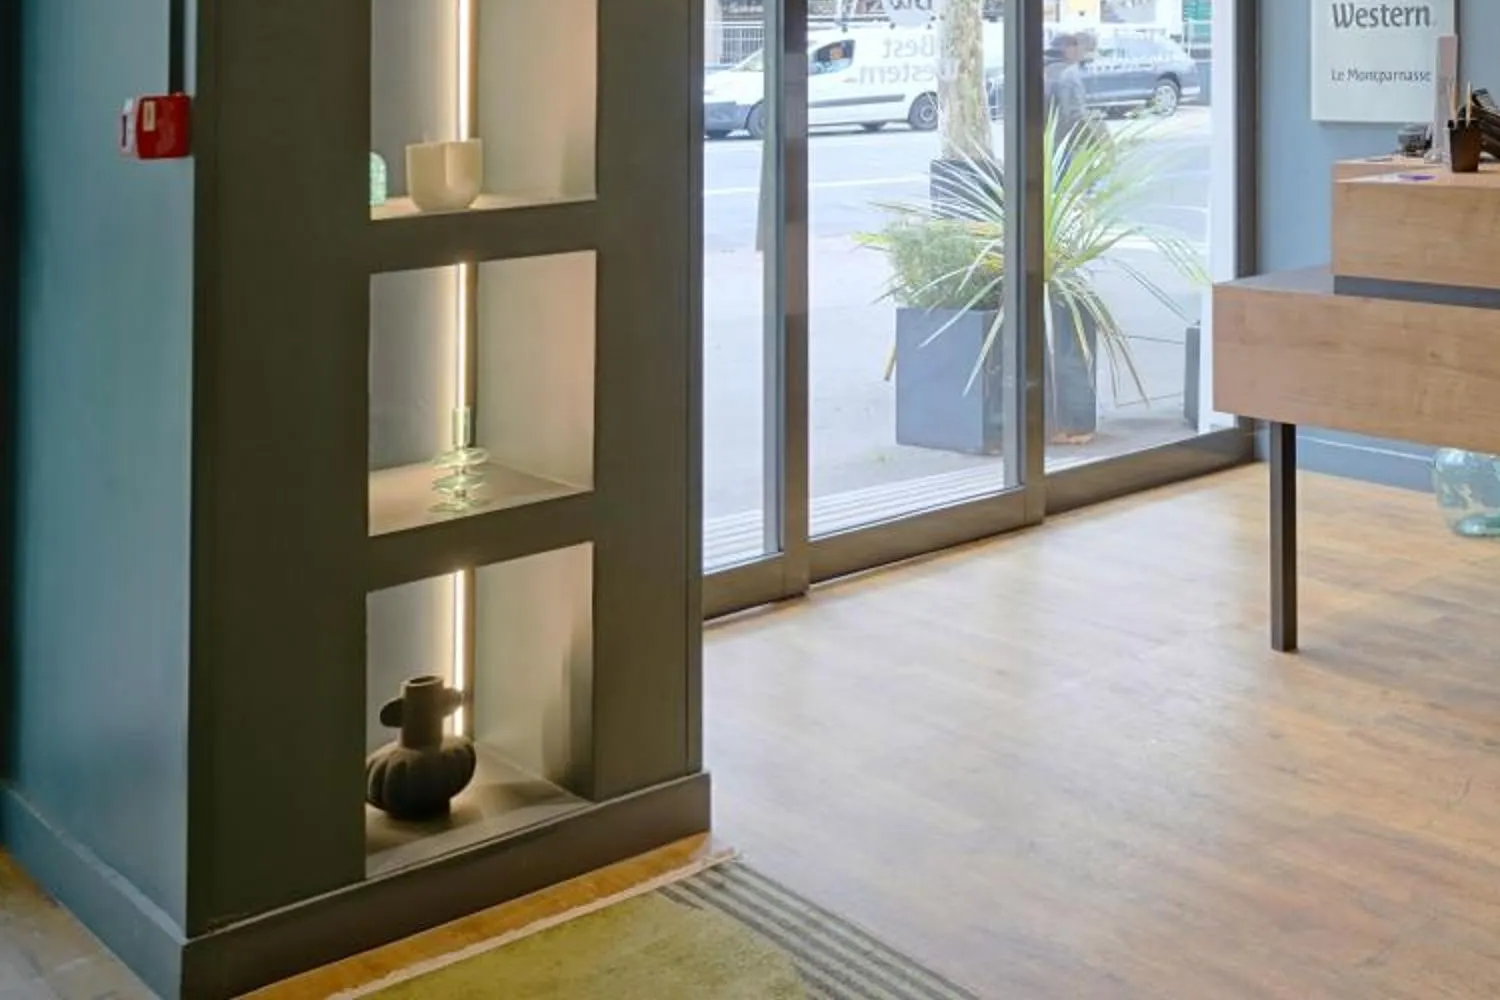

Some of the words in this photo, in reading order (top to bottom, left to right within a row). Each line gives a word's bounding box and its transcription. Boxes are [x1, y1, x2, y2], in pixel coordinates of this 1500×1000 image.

[1332, 2, 1431, 28] Western
[1331, 68, 1345, 82] Le
[1348, 68, 1432, 85] Montparnasse
